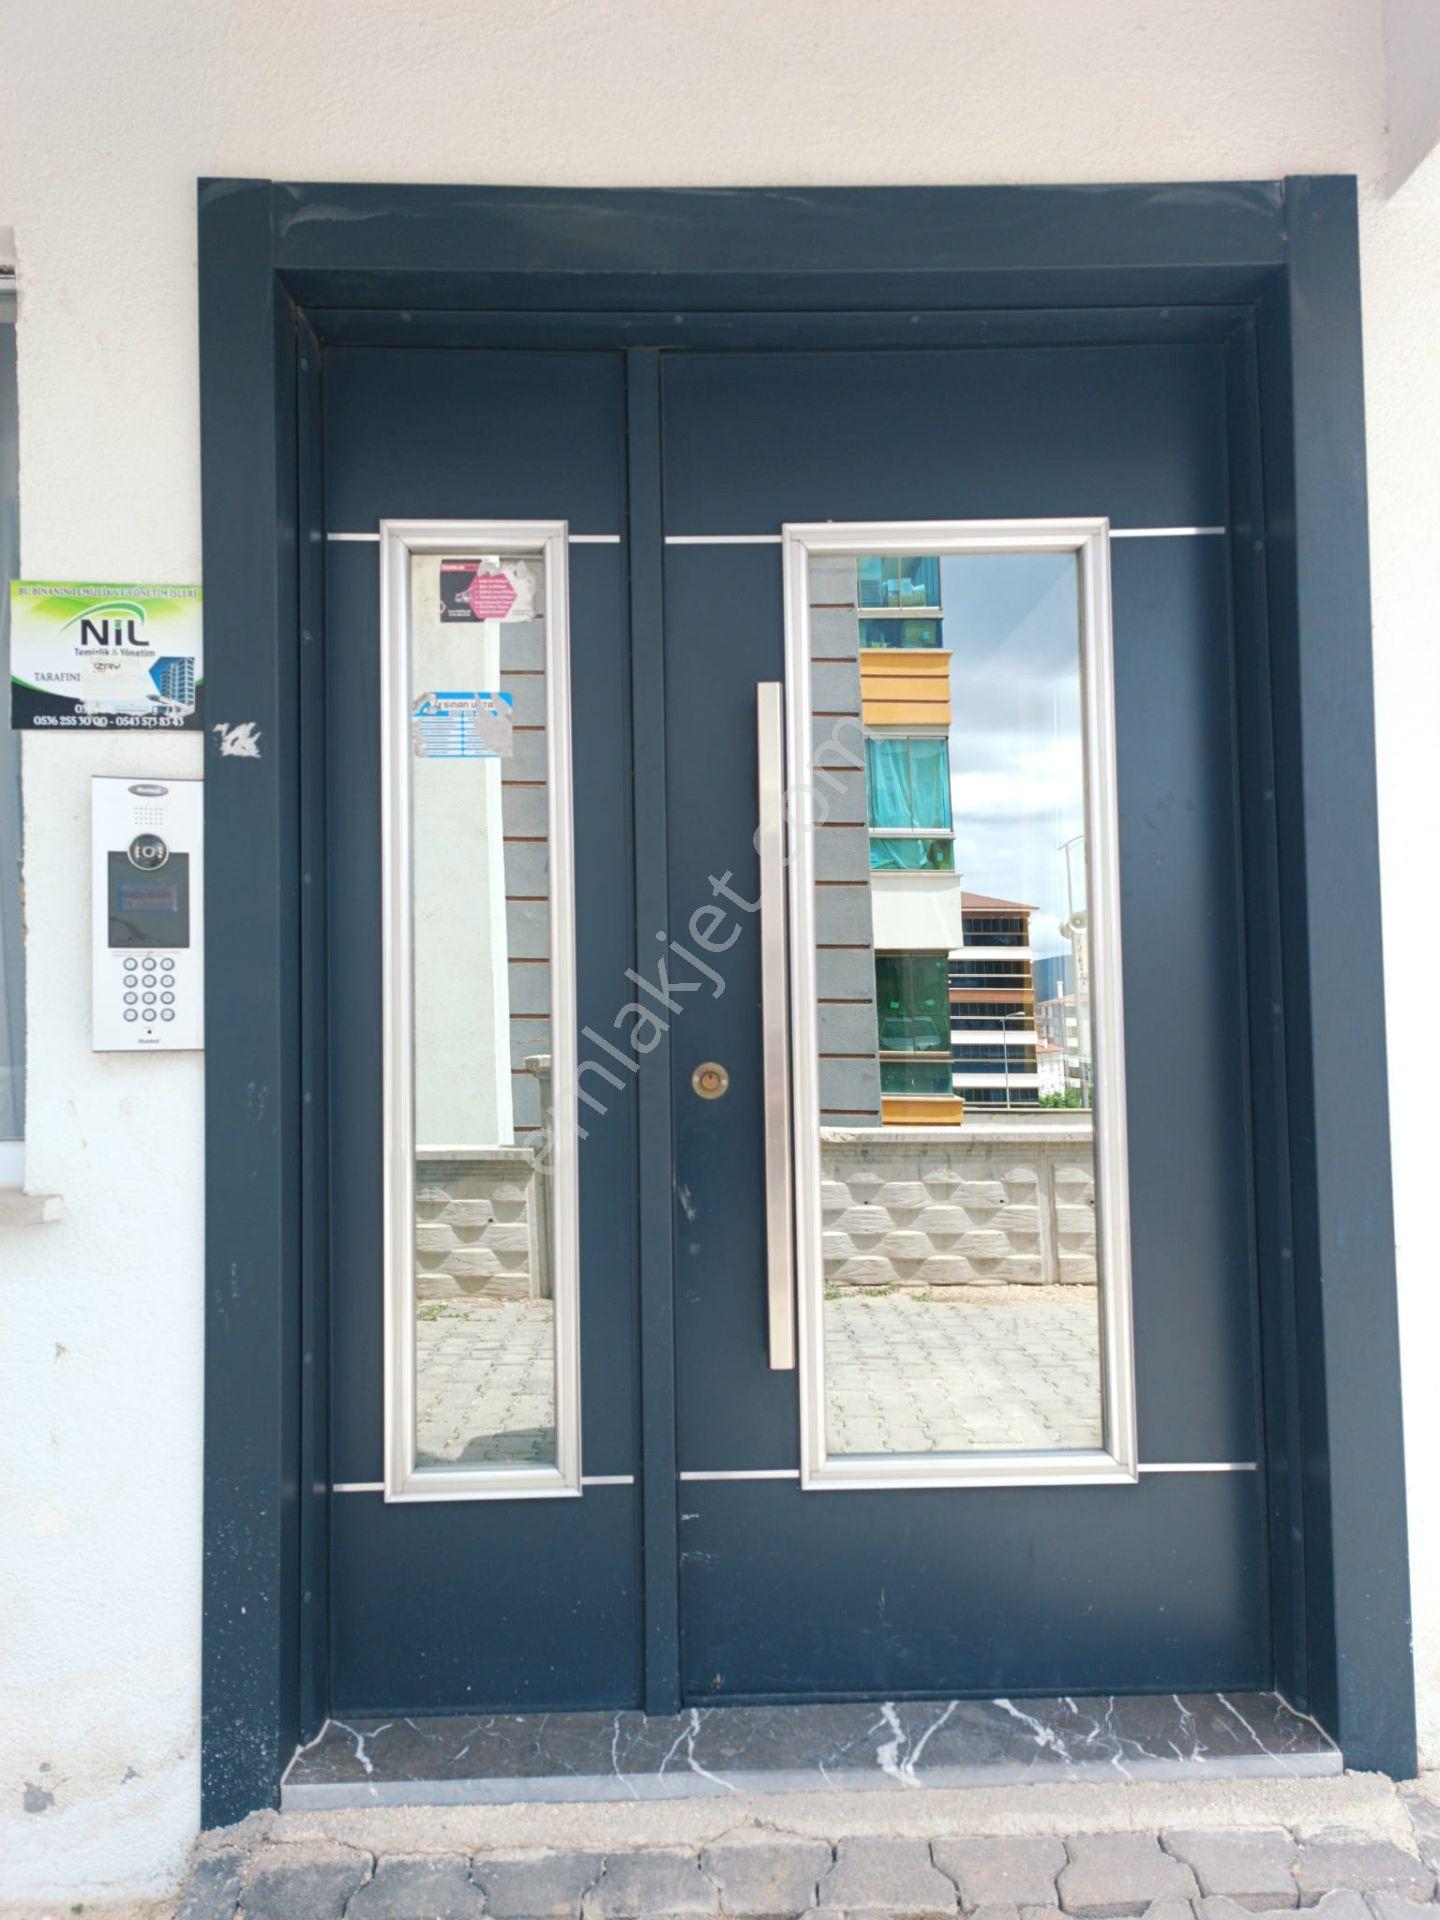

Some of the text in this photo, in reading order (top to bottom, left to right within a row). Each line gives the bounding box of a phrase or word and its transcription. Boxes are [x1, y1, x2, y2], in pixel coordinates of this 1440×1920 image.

[74, 647, 110, 657] Temizlik
[120, 647, 156, 657] Yönetim
[33, 715, 59, 726] 0536
[59, 715, 77, 726] 255
[115, 716, 140, 727] 0543
